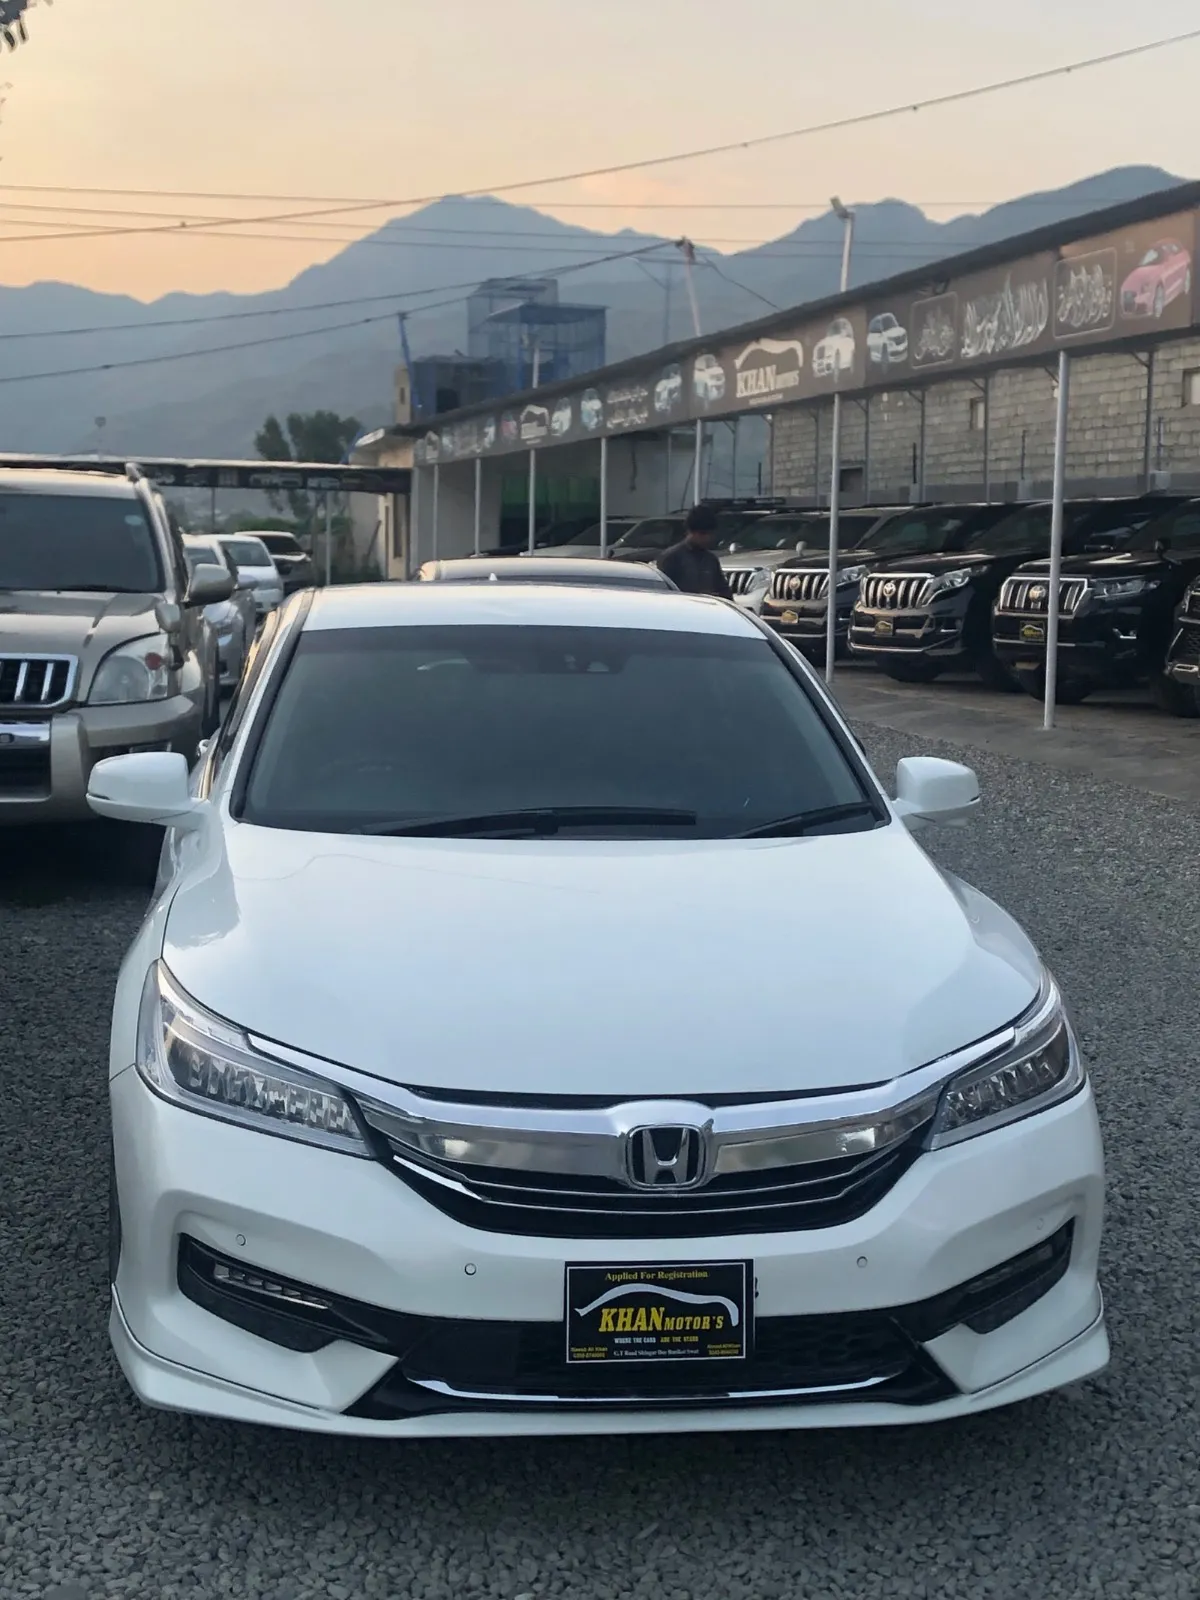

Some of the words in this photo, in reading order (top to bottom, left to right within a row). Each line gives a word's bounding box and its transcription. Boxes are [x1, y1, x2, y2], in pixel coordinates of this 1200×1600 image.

[736, 364, 777, 399] KHAN
[604, 1272, 638, 1282] Applied
[640, 1271, 656, 1279] For
[657, 1270, 708, 1280] Registration
[599, 1307, 665, 1332] KHAN
[663, 1315, 724, 1331] MOTOR'S
